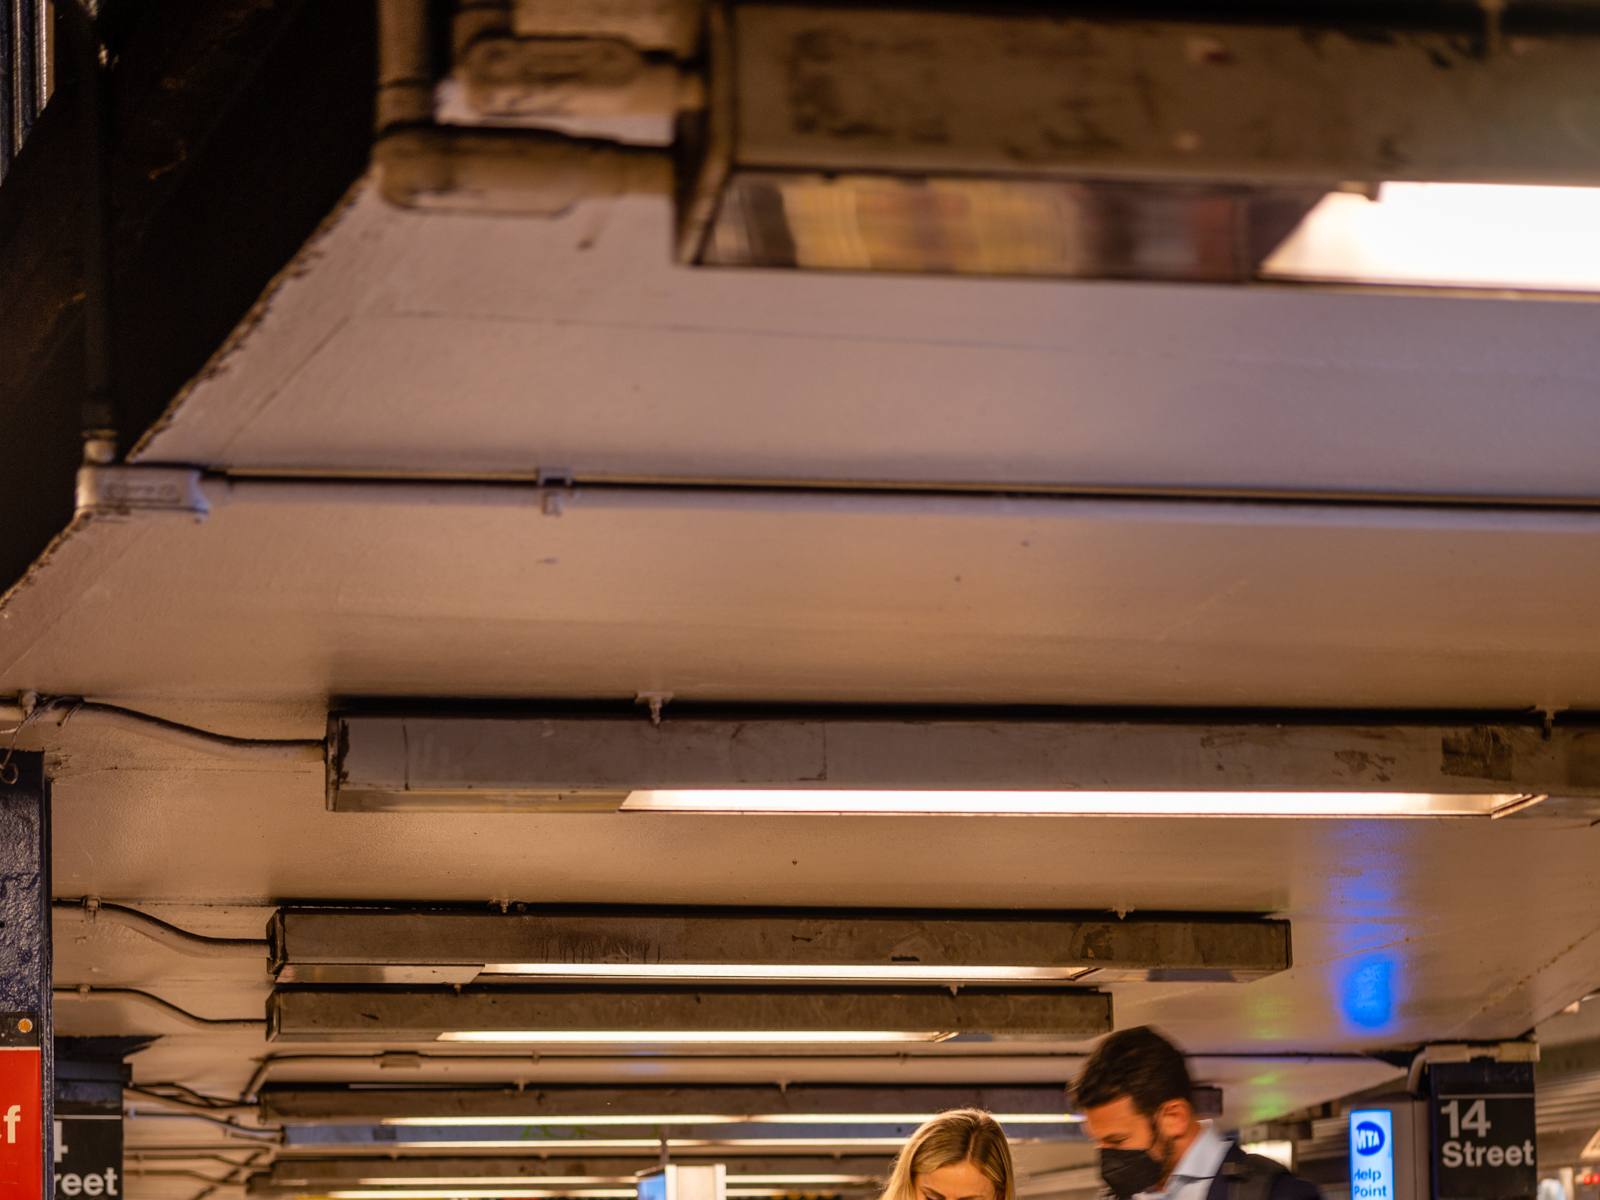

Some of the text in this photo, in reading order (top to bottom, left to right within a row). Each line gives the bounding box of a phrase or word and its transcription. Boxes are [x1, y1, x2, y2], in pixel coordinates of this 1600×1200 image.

[1440, 1100, 1492, 1138] 14
[1356, 1128, 1381, 1151] MTA
[1441, 1139, 1535, 1168] Street
[1353, 1168, 1382, 1183] Help
[1354, 1185, 1387, 1198] Point
